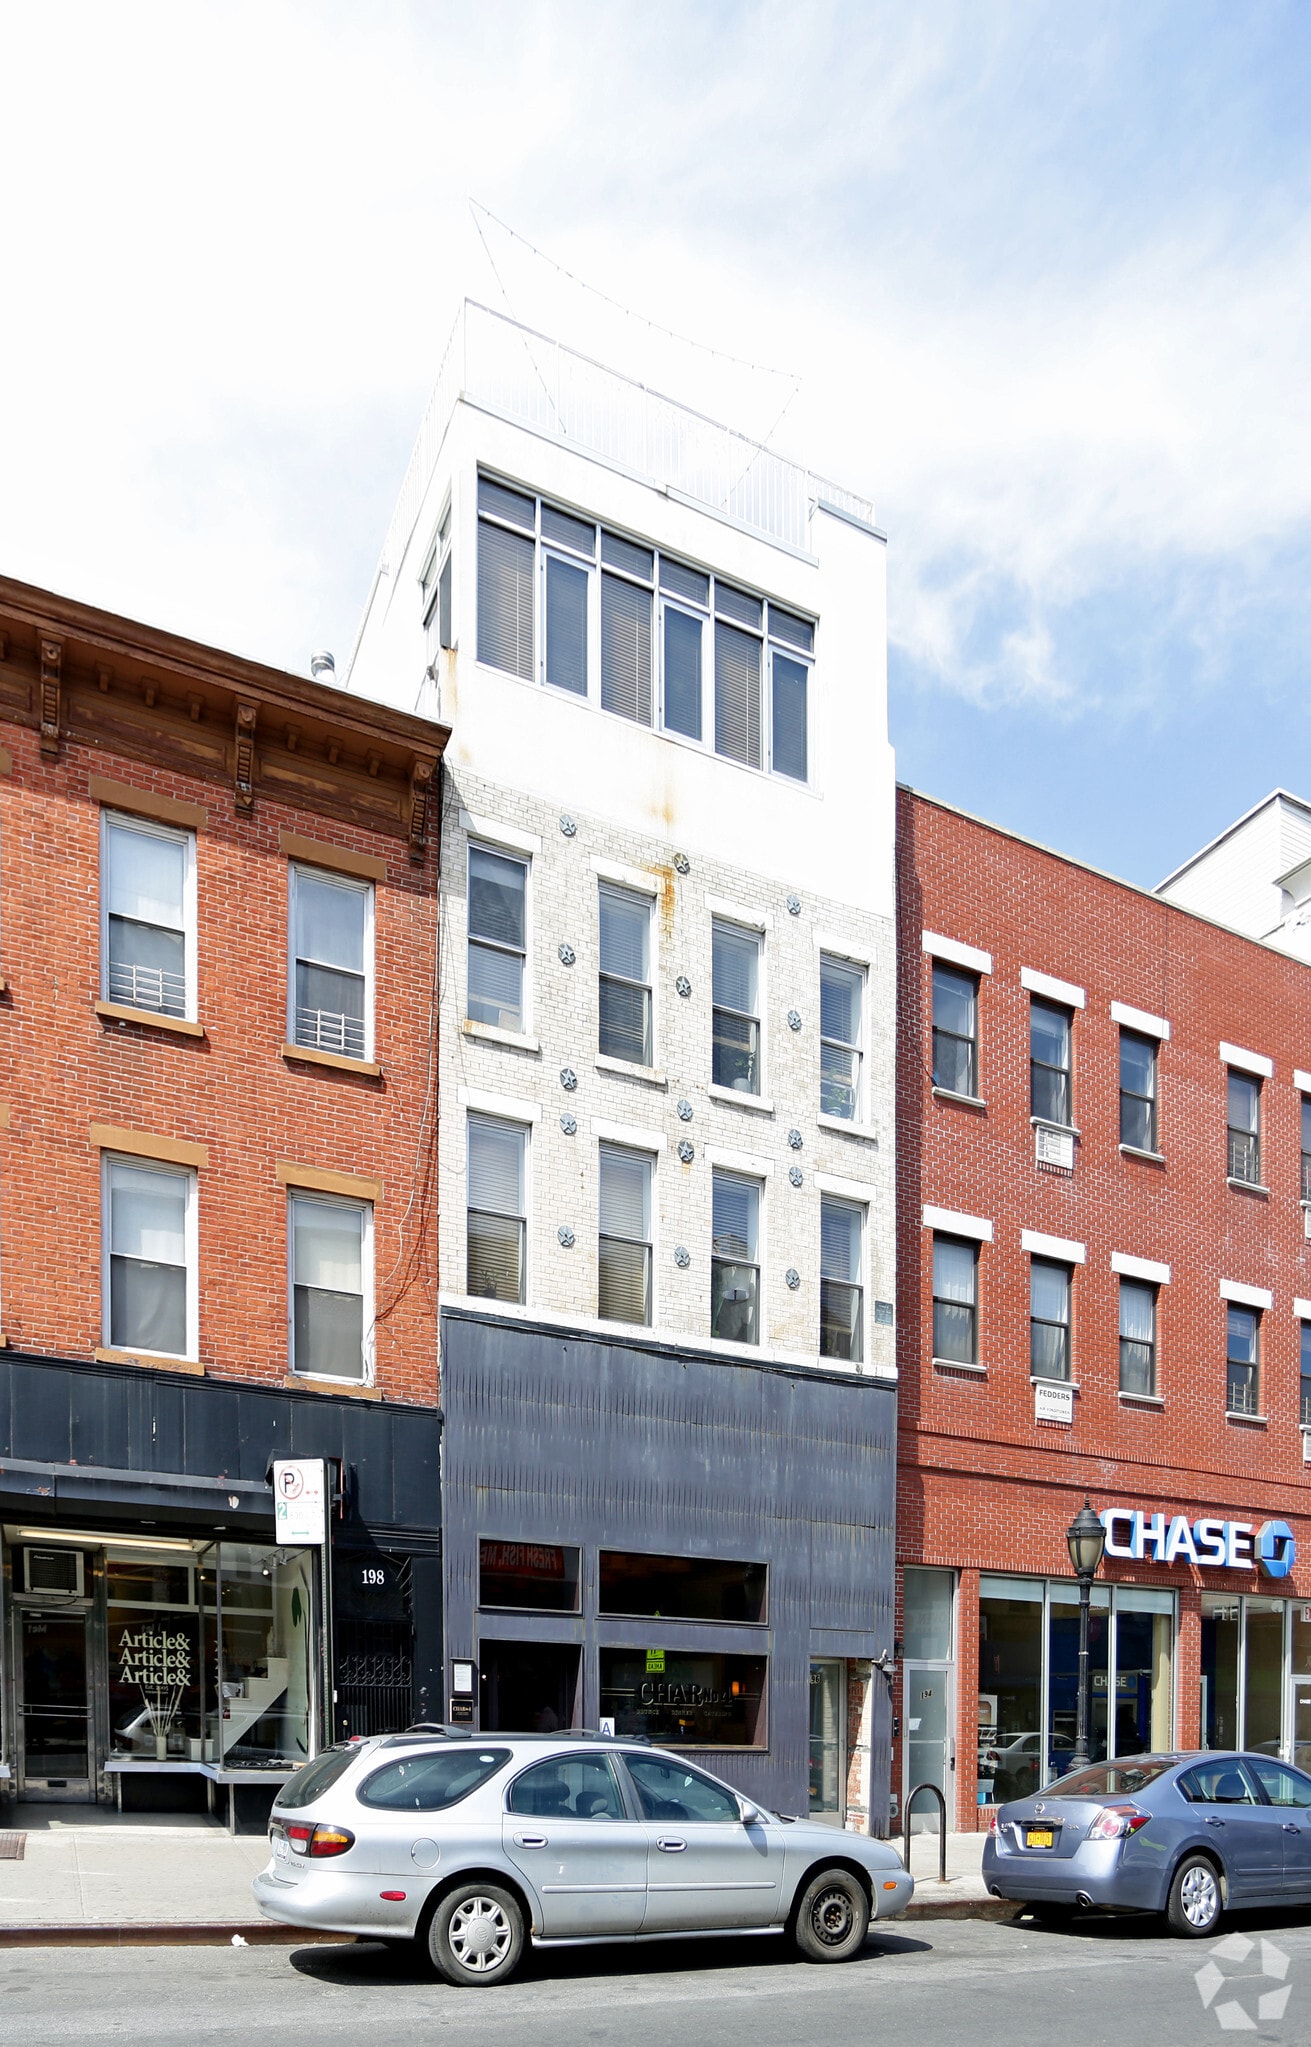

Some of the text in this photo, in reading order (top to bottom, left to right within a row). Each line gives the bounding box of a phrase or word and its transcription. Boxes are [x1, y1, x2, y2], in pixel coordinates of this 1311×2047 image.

[1039, 1389, 1070, 1401] FEDDERS
[1101, 1508, 1255, 1569] CHASE
[361, 1569, 385, 1585] 198
[118, 1629, 192, 1650] Article&
[118, 1647, 192, 1668] Article&
[118, 1665, 192, 1686] Article&
[1094, 1675, 1127, 1687] CHSE
[641, 1682, 705, 1707] CHAR
[921, 1689, 933, 1700] 194
[602, 1721, 612, 1737] A
